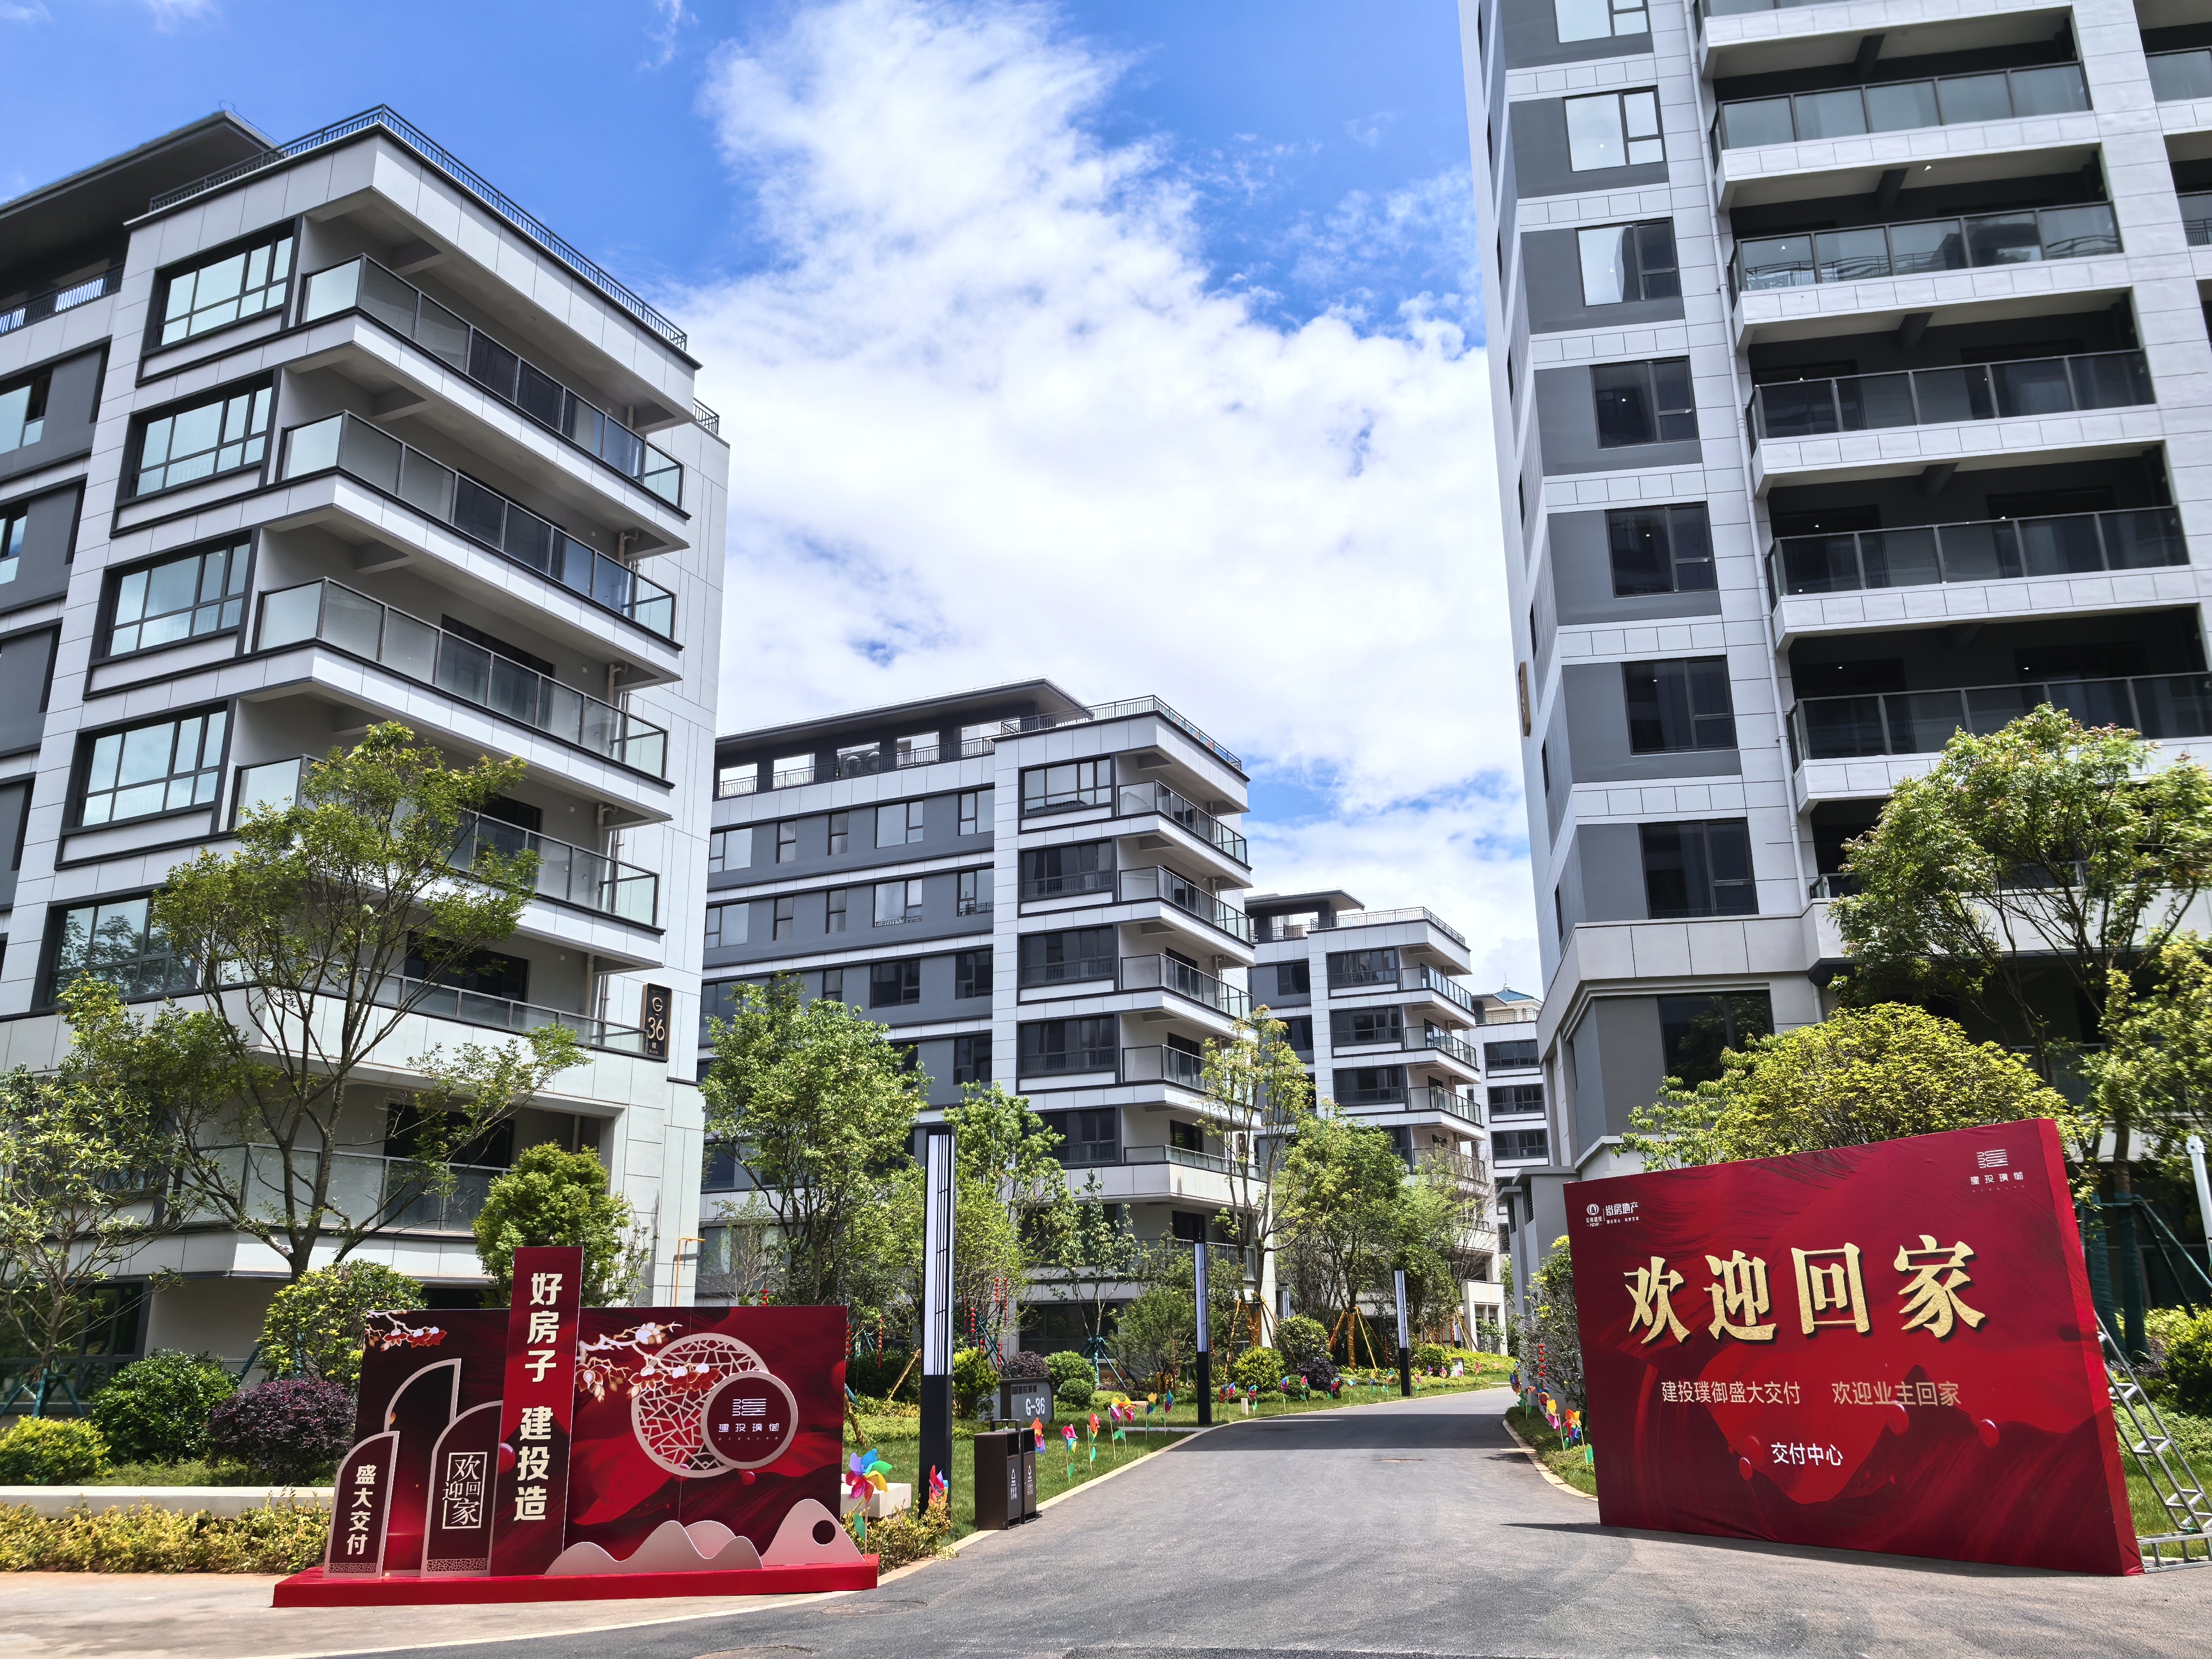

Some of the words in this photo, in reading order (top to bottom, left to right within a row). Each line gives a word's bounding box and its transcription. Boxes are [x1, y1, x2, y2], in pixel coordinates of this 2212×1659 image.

[1623, 1235, 1986, 1344] 欢迎回家
[524, 1272, 562, 1382] 好房子
[1026, 1397, 1045, 1416] G-36
[1661, 1380, 1800, 1404] 建投璞御盛大交付
[1831, 1380, 1961, 1406] 欢迎业主回家
[718, 1422, 779, 1433] 建投璞御
[1771, 1442, 1843, 1466] 交付中心
[513, 1406, 553, 1522] 建投造
[347, 1465, 377, 1555] 盛大交付
